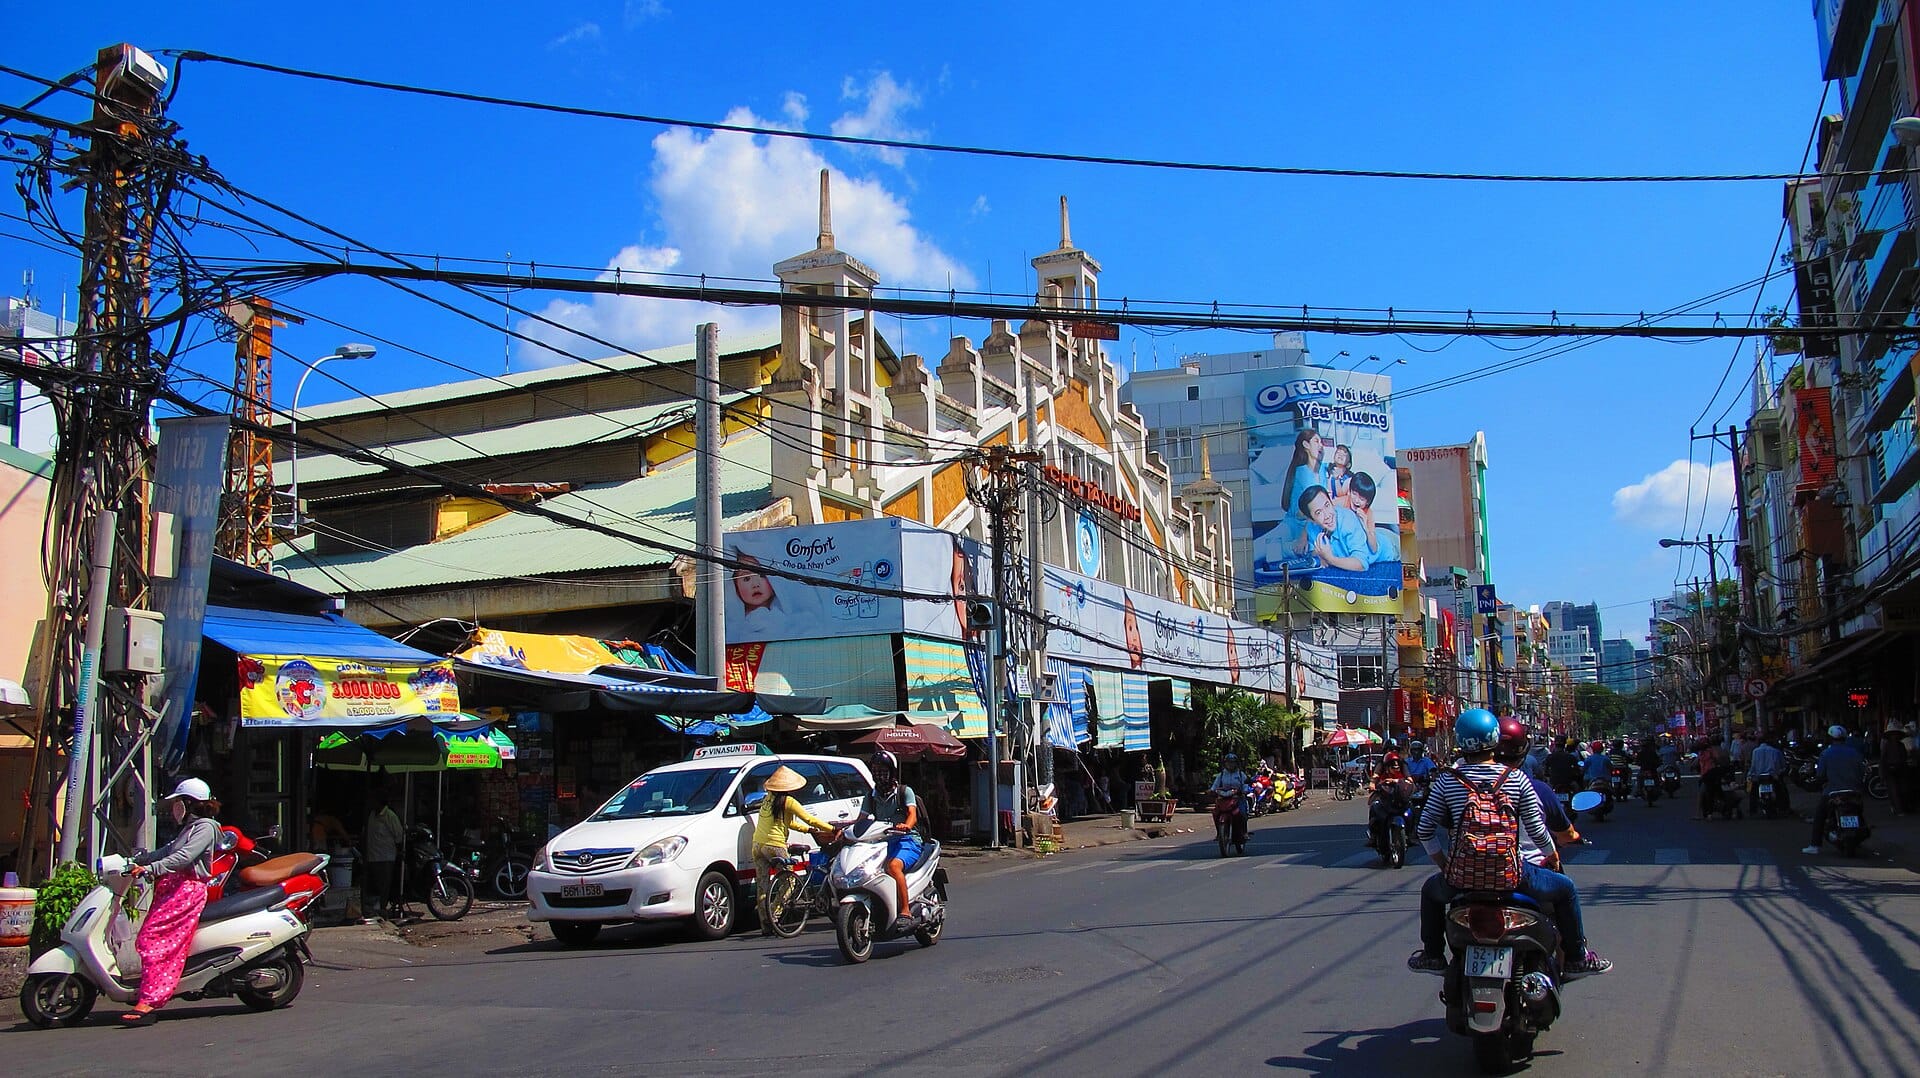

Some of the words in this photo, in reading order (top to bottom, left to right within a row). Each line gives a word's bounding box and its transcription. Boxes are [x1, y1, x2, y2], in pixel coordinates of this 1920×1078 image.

[1258, 379, 1331, 408] OREO
[1336, 387, 1356, 401] Nối
[1360, 389, 1379, 403] kết
[1300, 402, 1328, 420] Yêu
[1333, 407, 1388, 428] Thương
[786, 536, 836, 562] Comfort
[783, 559, 796, 569] Cho
[797, 562, 806, 570] Da
[1479, 599, 1495, 610] PNJ
[709, 745, 740, 755] VINASUN
[741, 744, 756, 752] TAXI
[1471, 961, 1504, 976] 8714
